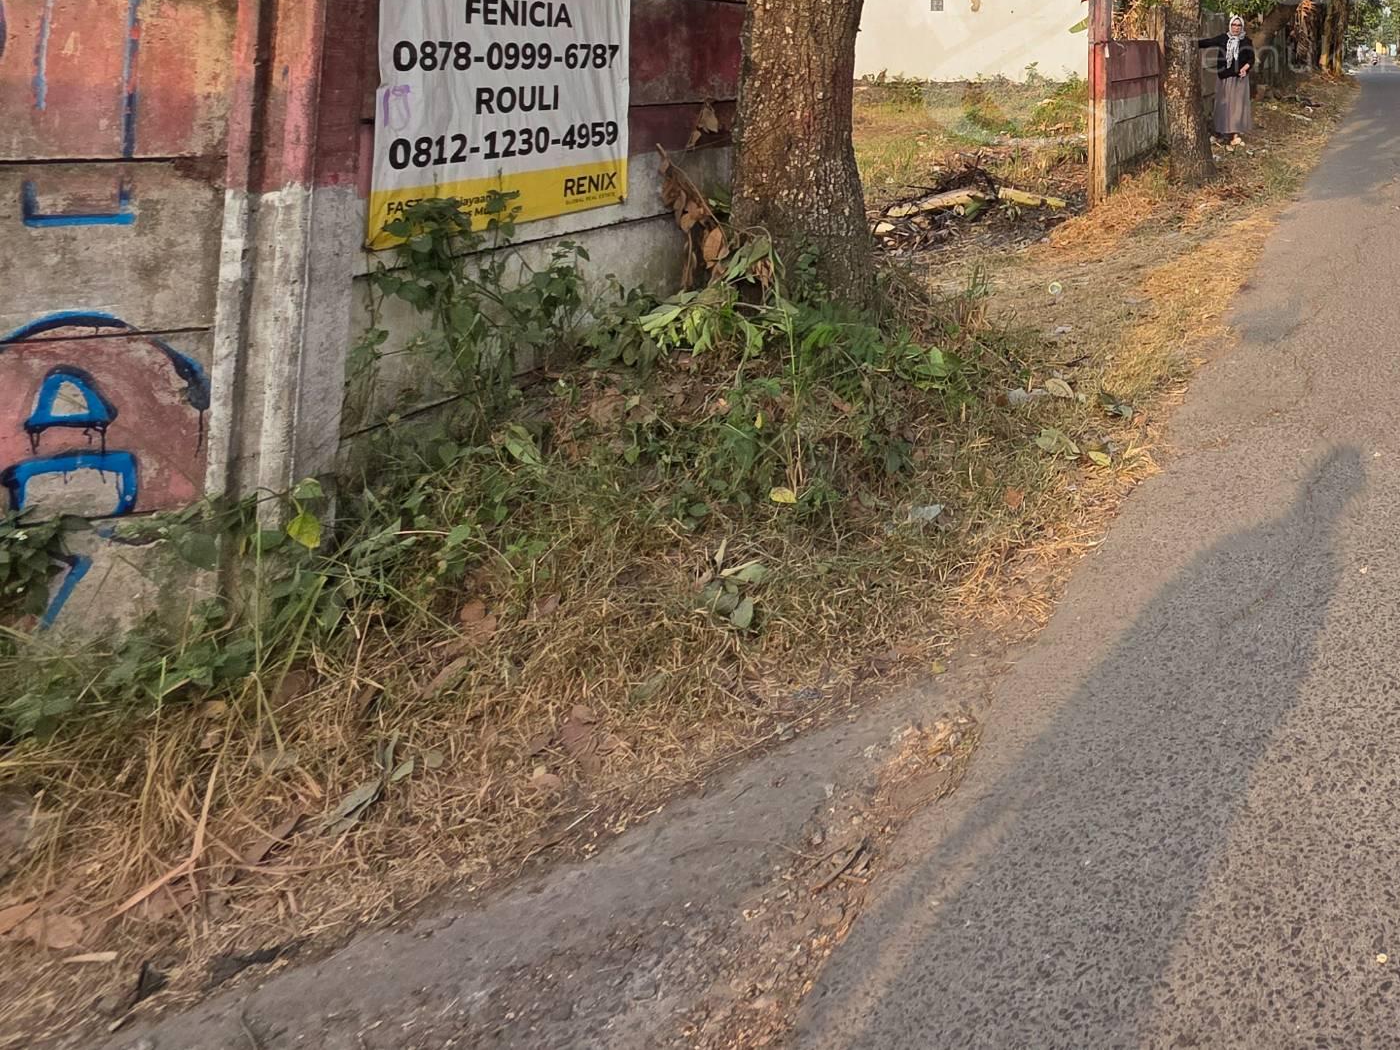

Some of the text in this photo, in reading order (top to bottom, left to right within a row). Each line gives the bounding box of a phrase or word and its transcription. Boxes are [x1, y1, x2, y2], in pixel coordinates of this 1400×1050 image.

[392, 40, 620, 72] 0878-0999-6787
[475, 85, 559, 115] ROULI
[388, 120, 619, 170] 0812-1230-4959
[563, 171, 617, 197] RENIX
